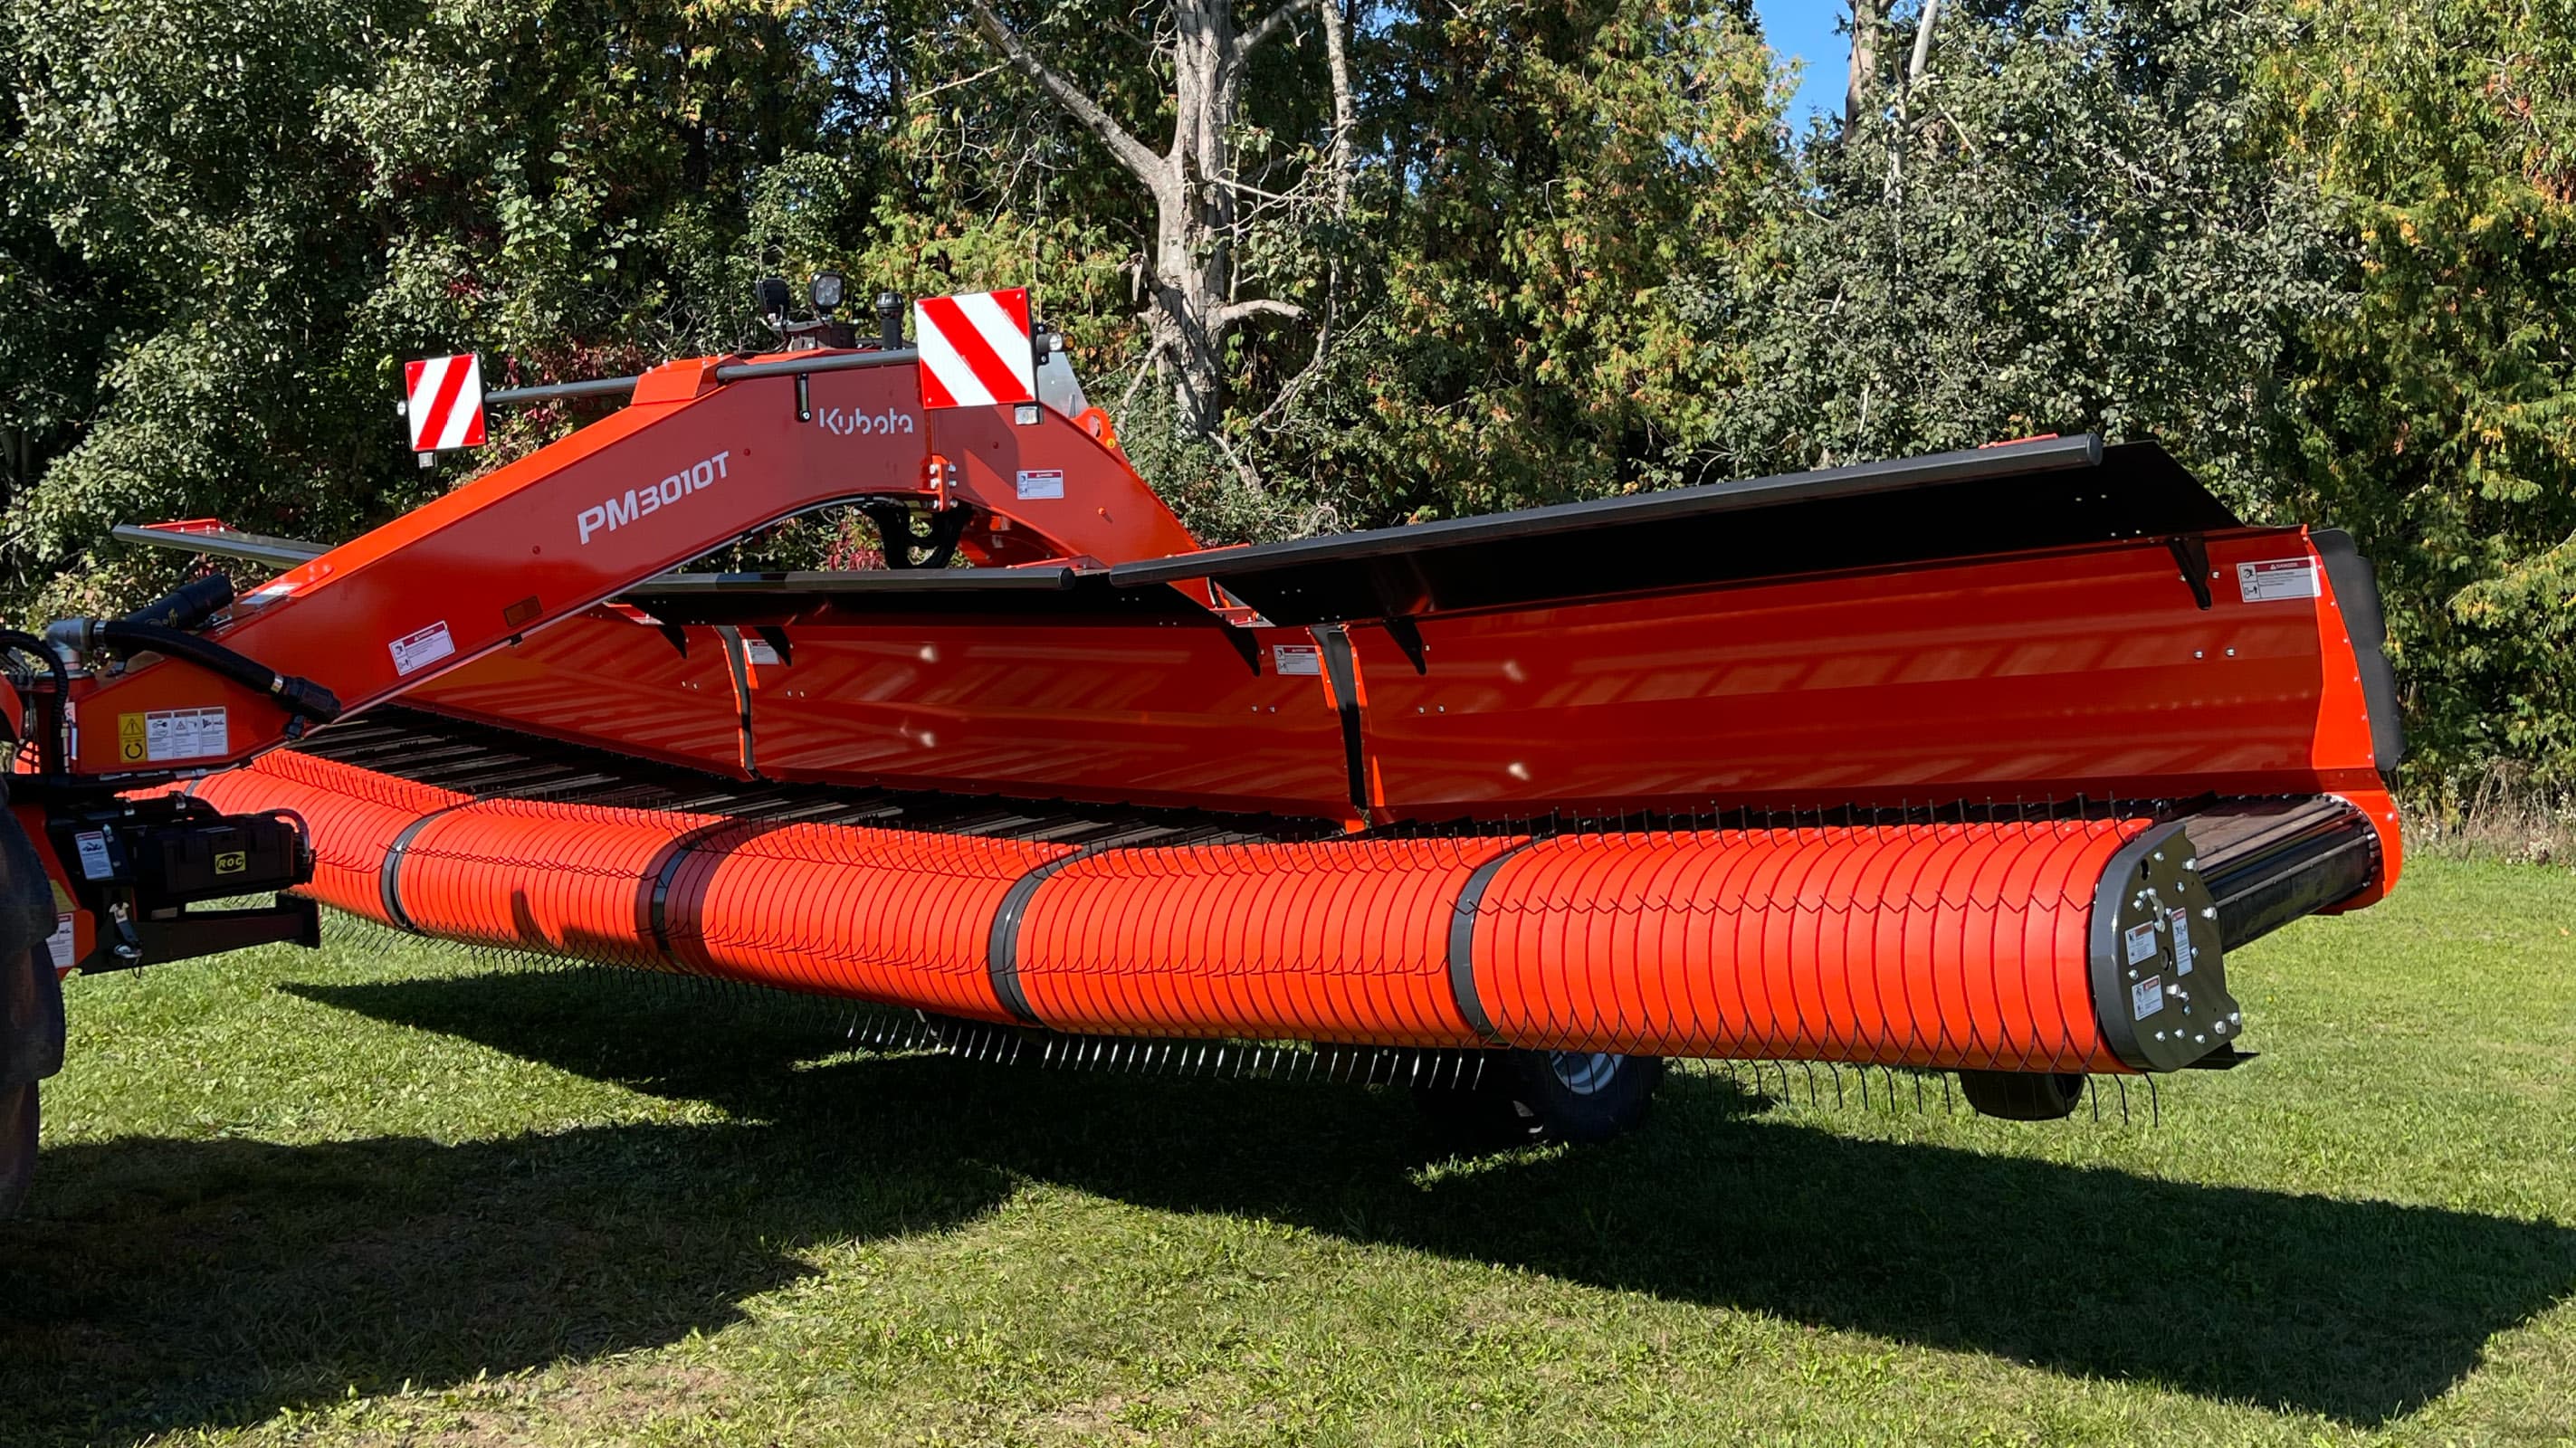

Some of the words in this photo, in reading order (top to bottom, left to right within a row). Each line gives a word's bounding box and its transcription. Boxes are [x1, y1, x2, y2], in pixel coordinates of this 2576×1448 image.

[819, 407, 913, 435] Kubota
[577, 450, 730, 545] PM3010T
[218, 857, 243, 868] ROC
